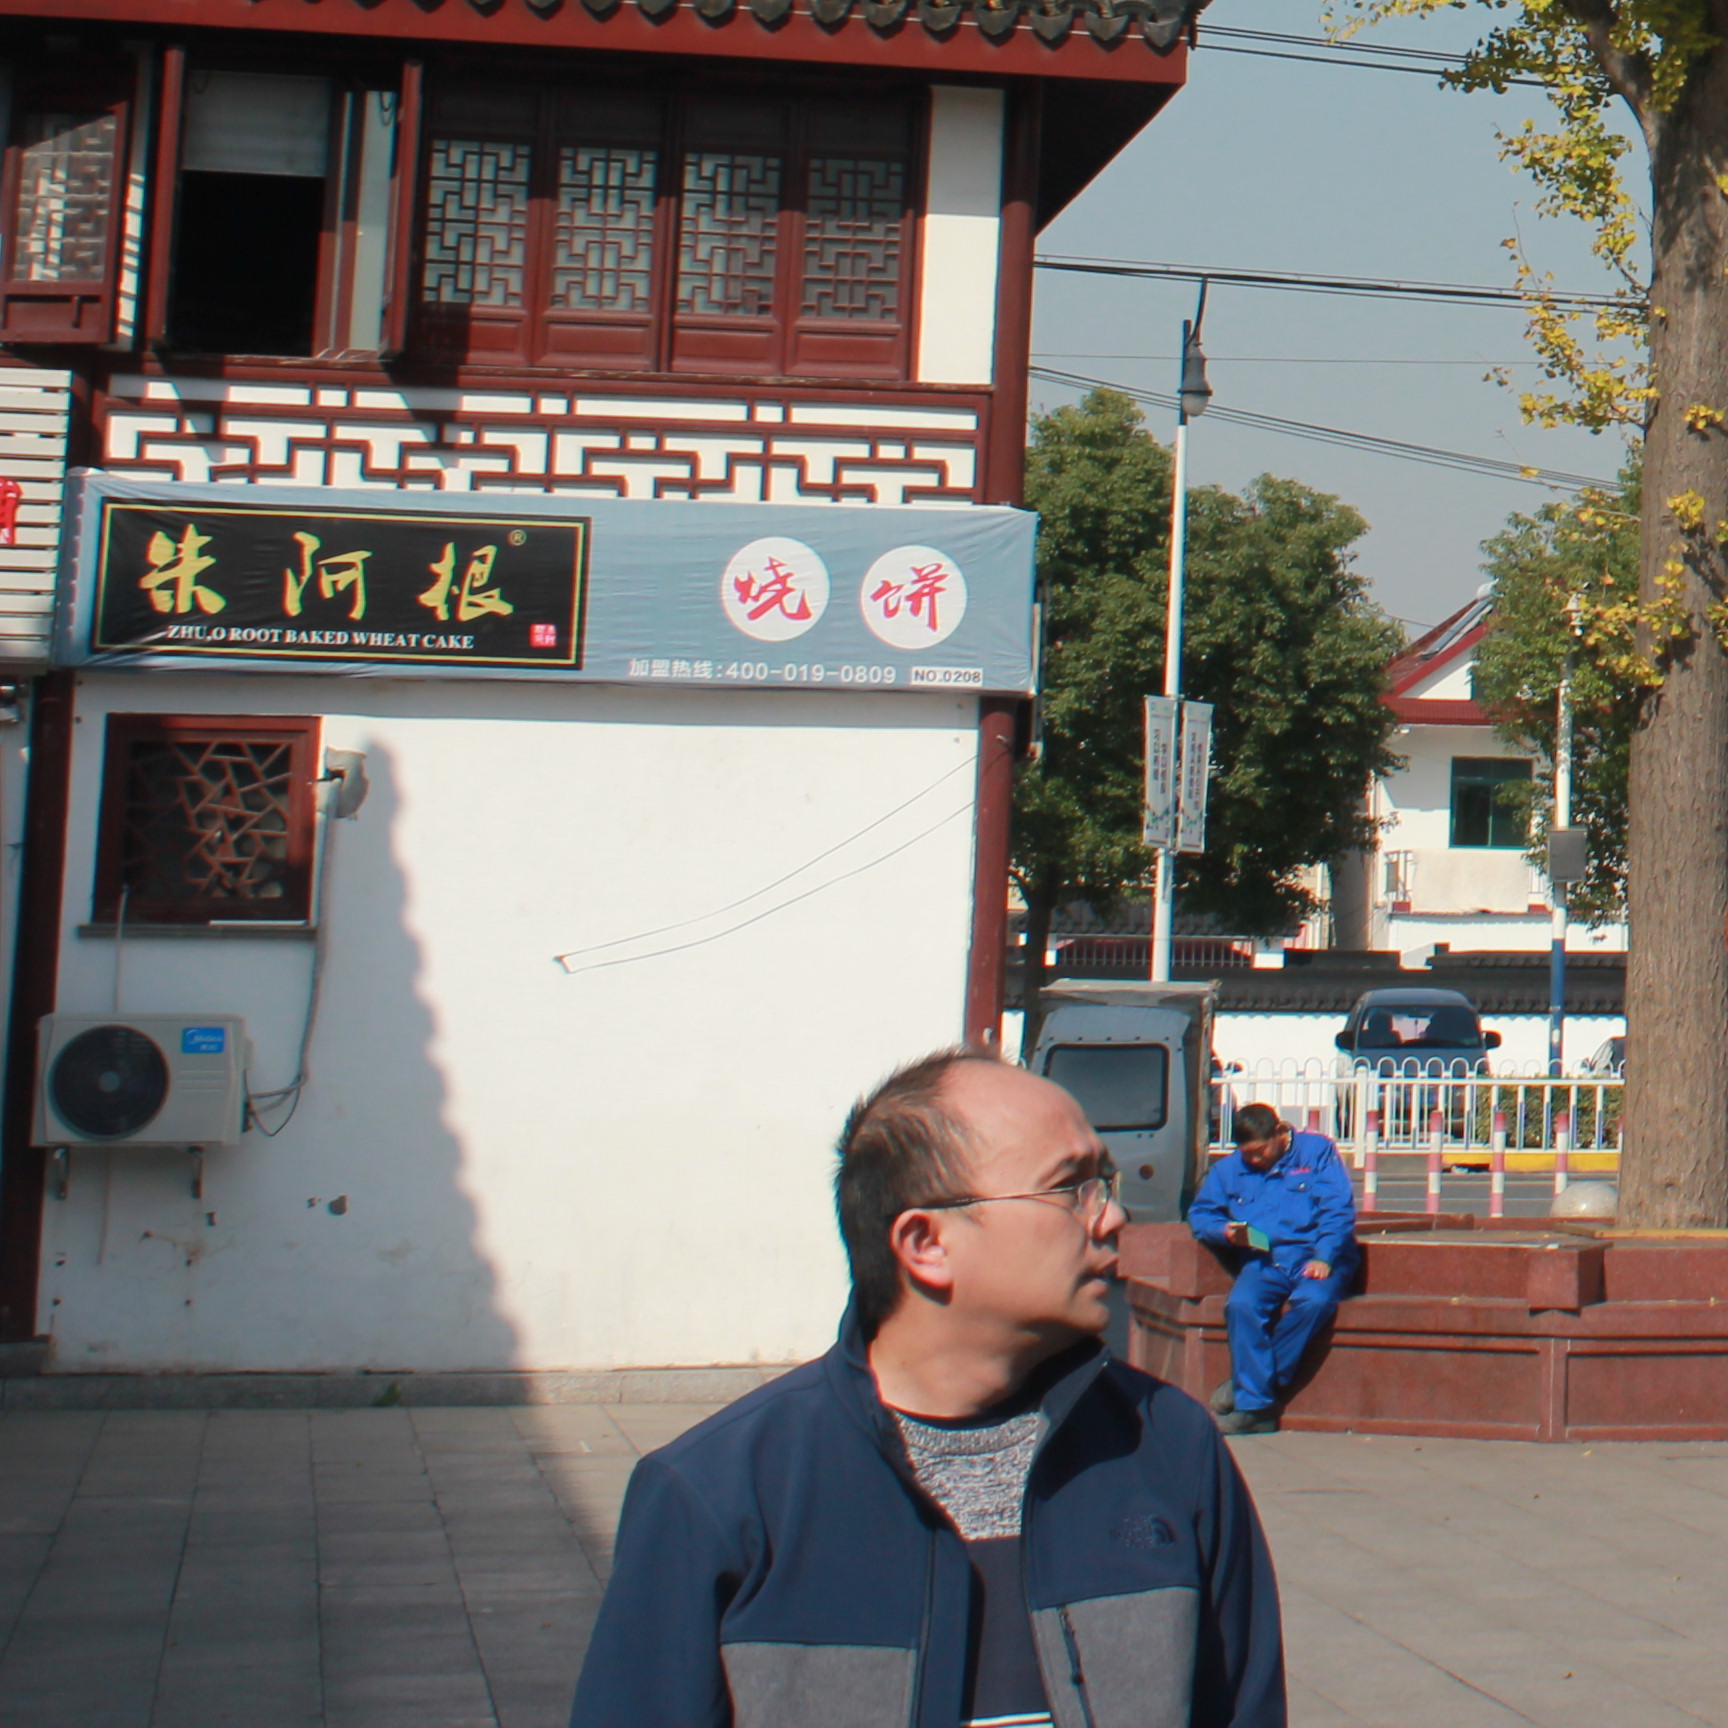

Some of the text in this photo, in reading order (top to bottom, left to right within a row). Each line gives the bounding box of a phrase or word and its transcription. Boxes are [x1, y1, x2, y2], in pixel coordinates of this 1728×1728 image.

[139, 523, 514, 622] 朱阿根
[734, 558, 948, 632] 烧饼
[228, 627, 282, 643] ROOT
[284, 629, 349, 645] BAKED
[351, 631, 420, 647] WHEAT
[421, 633, 474, 649] CAKE
[913, 668, 982, 684] NO.0208
